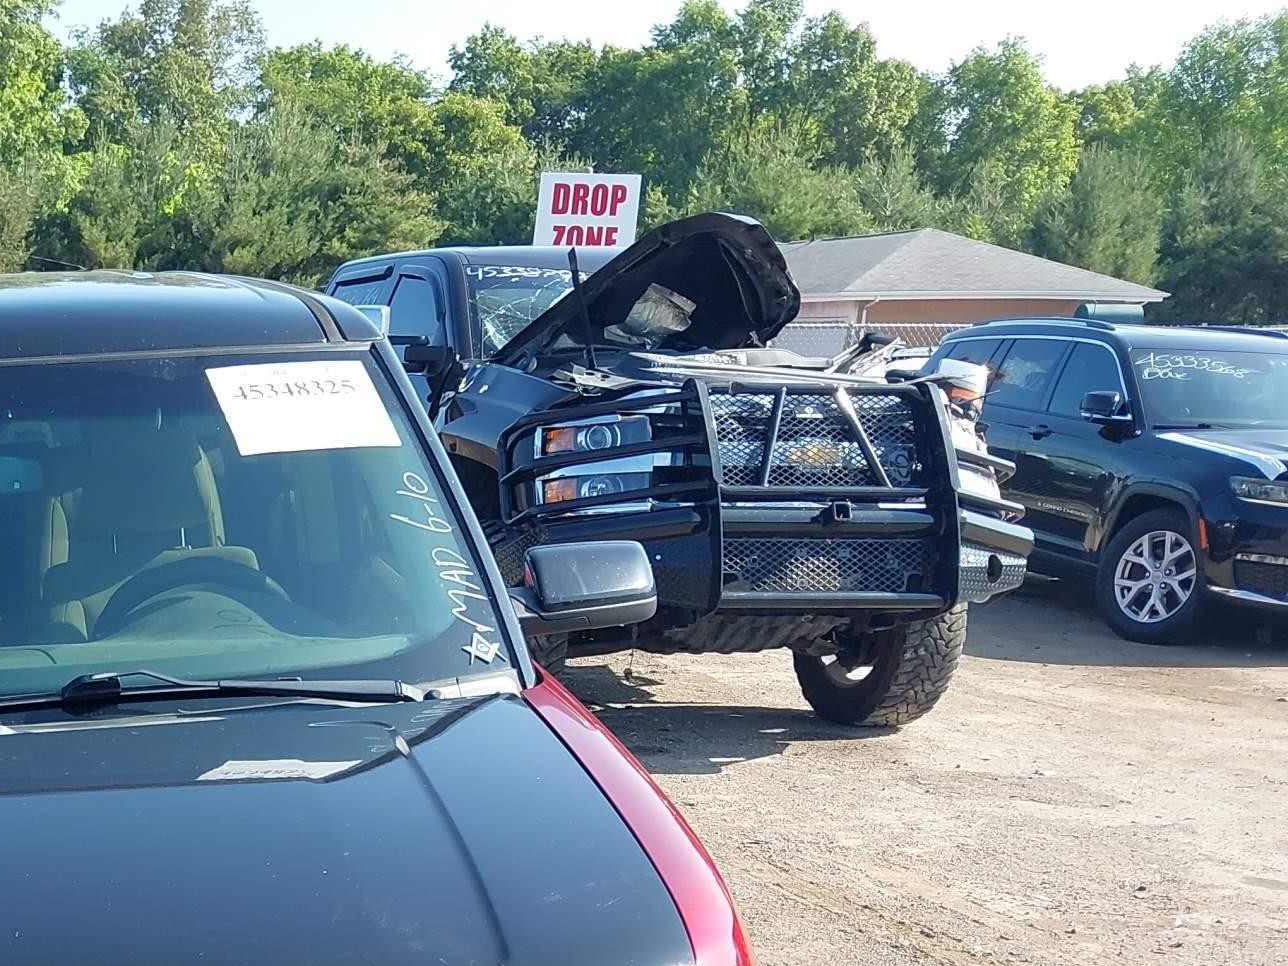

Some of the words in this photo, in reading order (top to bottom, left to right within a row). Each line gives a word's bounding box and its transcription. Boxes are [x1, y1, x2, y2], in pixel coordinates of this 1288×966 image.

[551, 183, 627, 216] DROP
[233, 379, 357, 400] 45348325
[390, 471, 452, 533] 6-10
